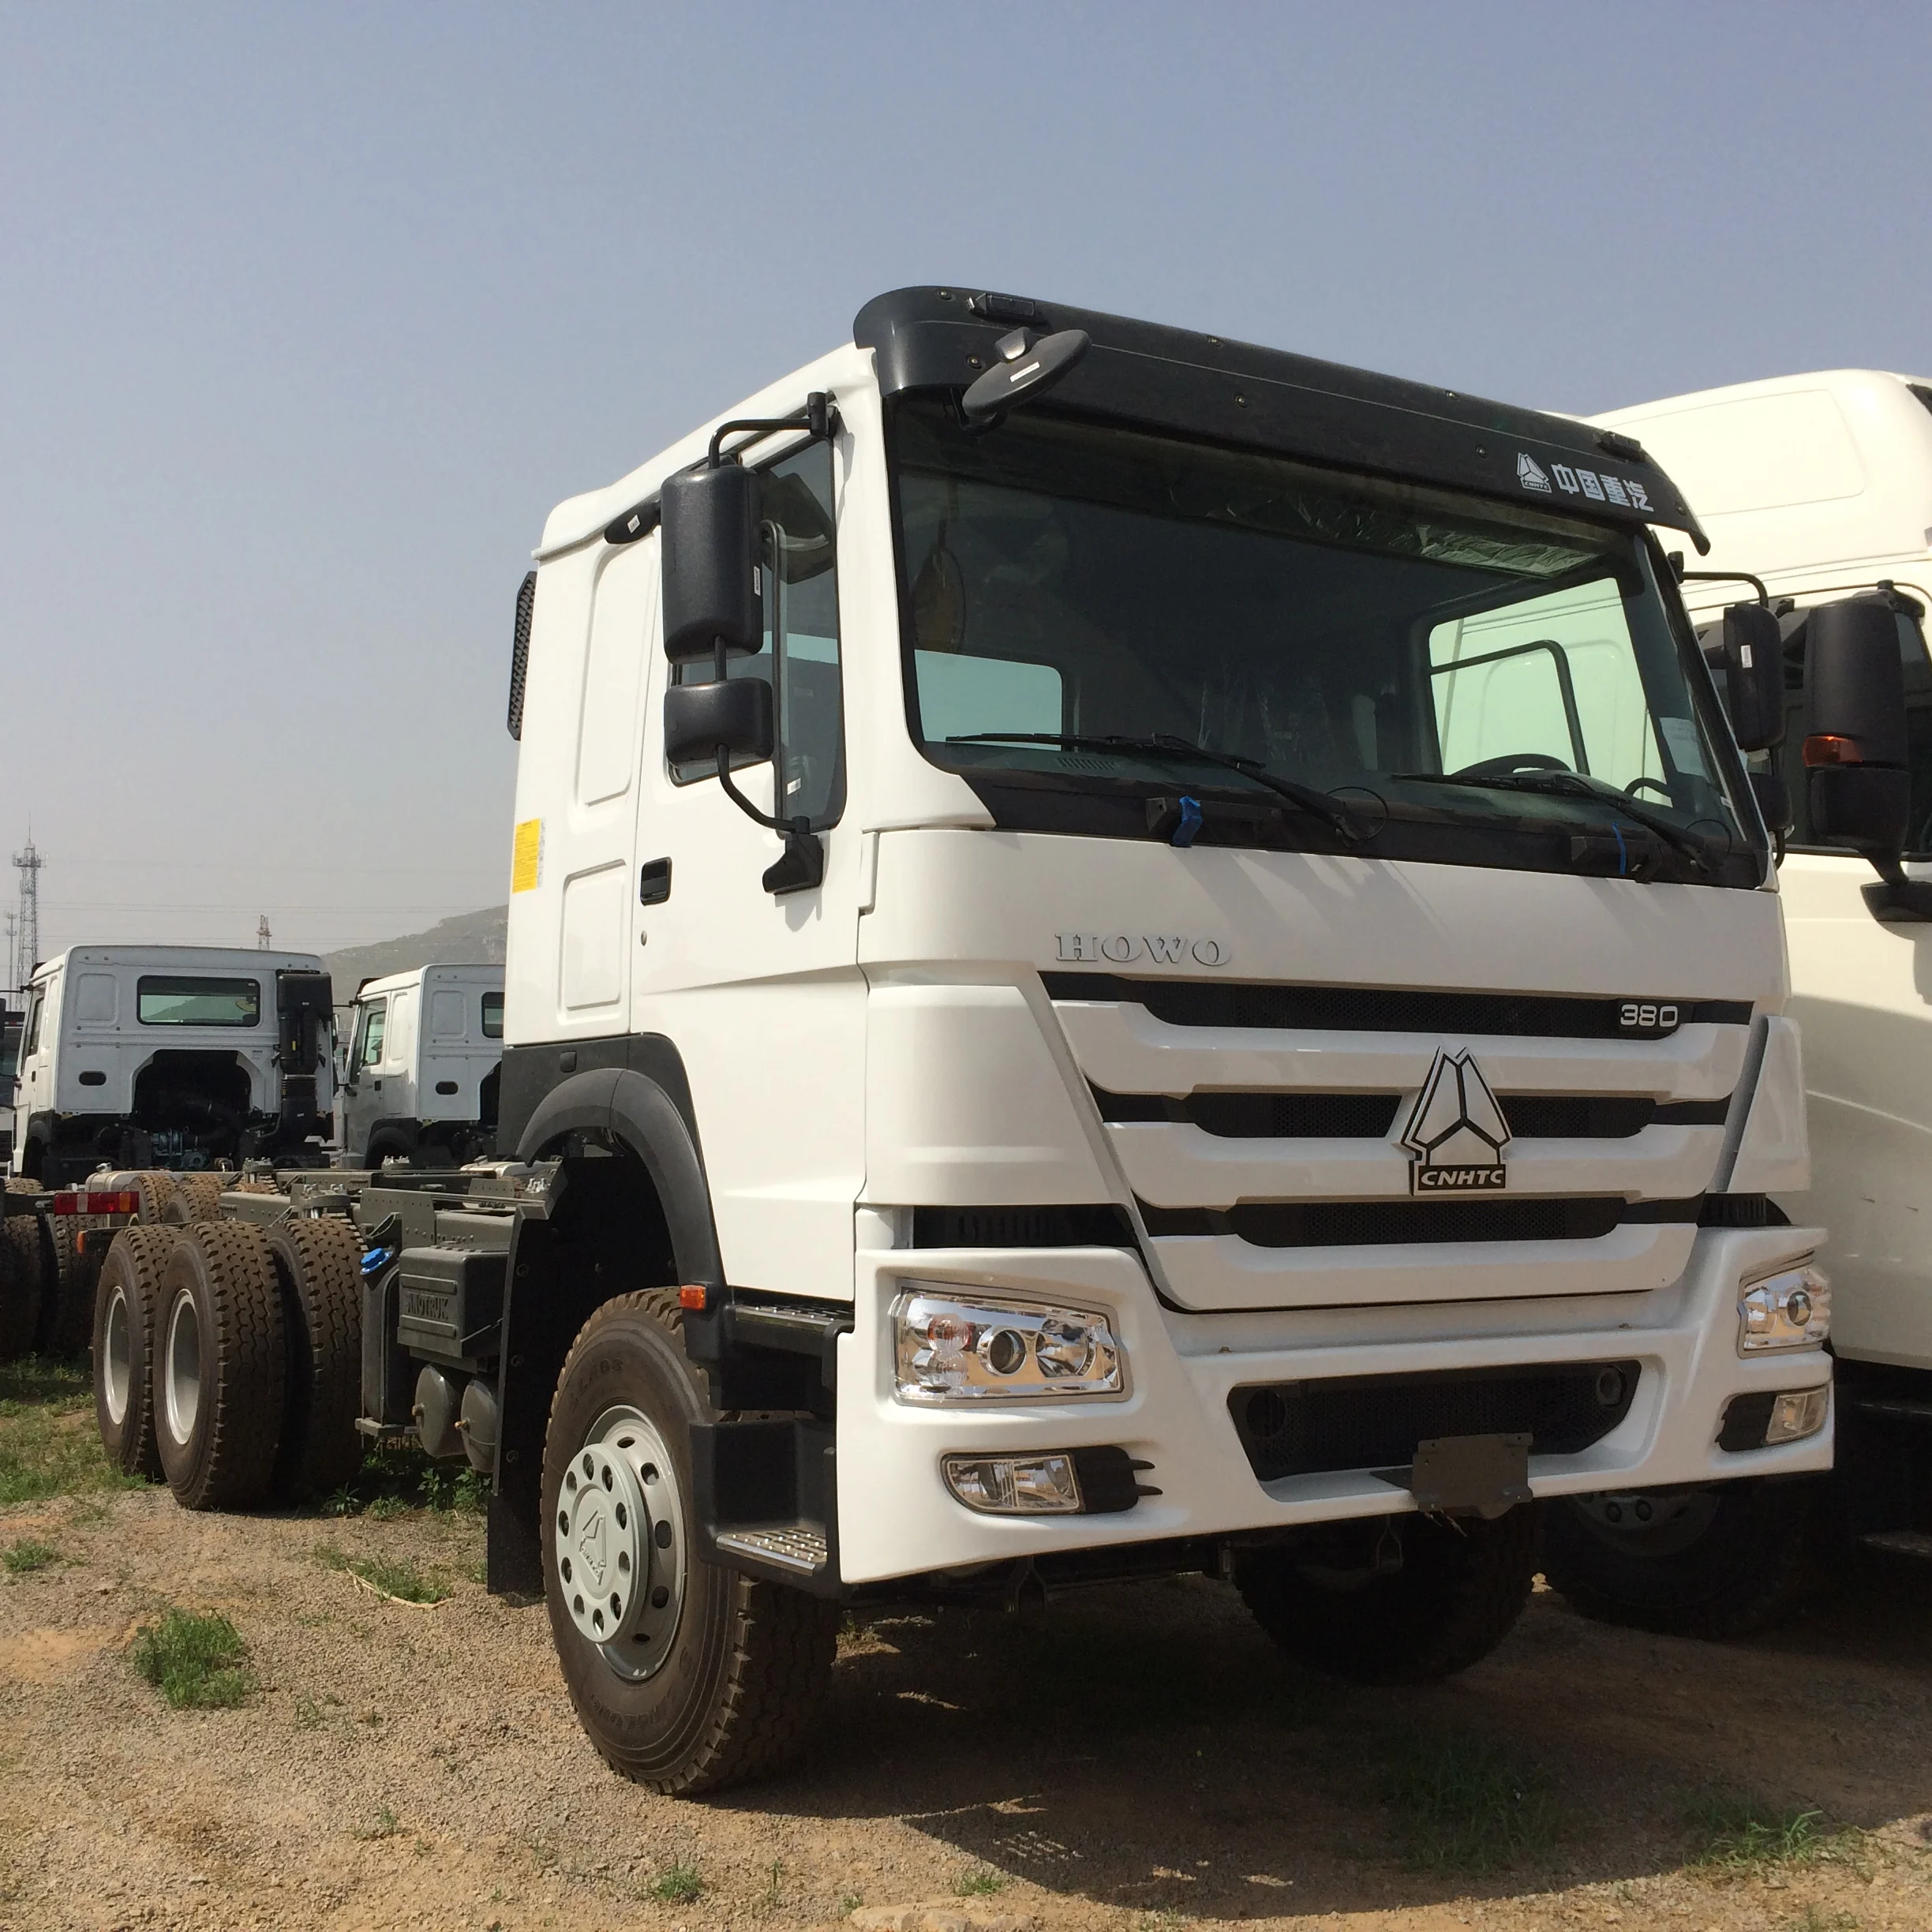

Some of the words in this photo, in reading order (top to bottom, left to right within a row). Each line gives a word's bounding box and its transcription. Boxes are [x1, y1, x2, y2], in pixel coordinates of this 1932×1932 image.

[1551, 463, 1654, 511] 中国重汽
[1054, 932, 1233, 967] HOWO
[1620, 1004, 1678, 1027] 380
[1421, 1170, 1504, 1185] CNHTC
